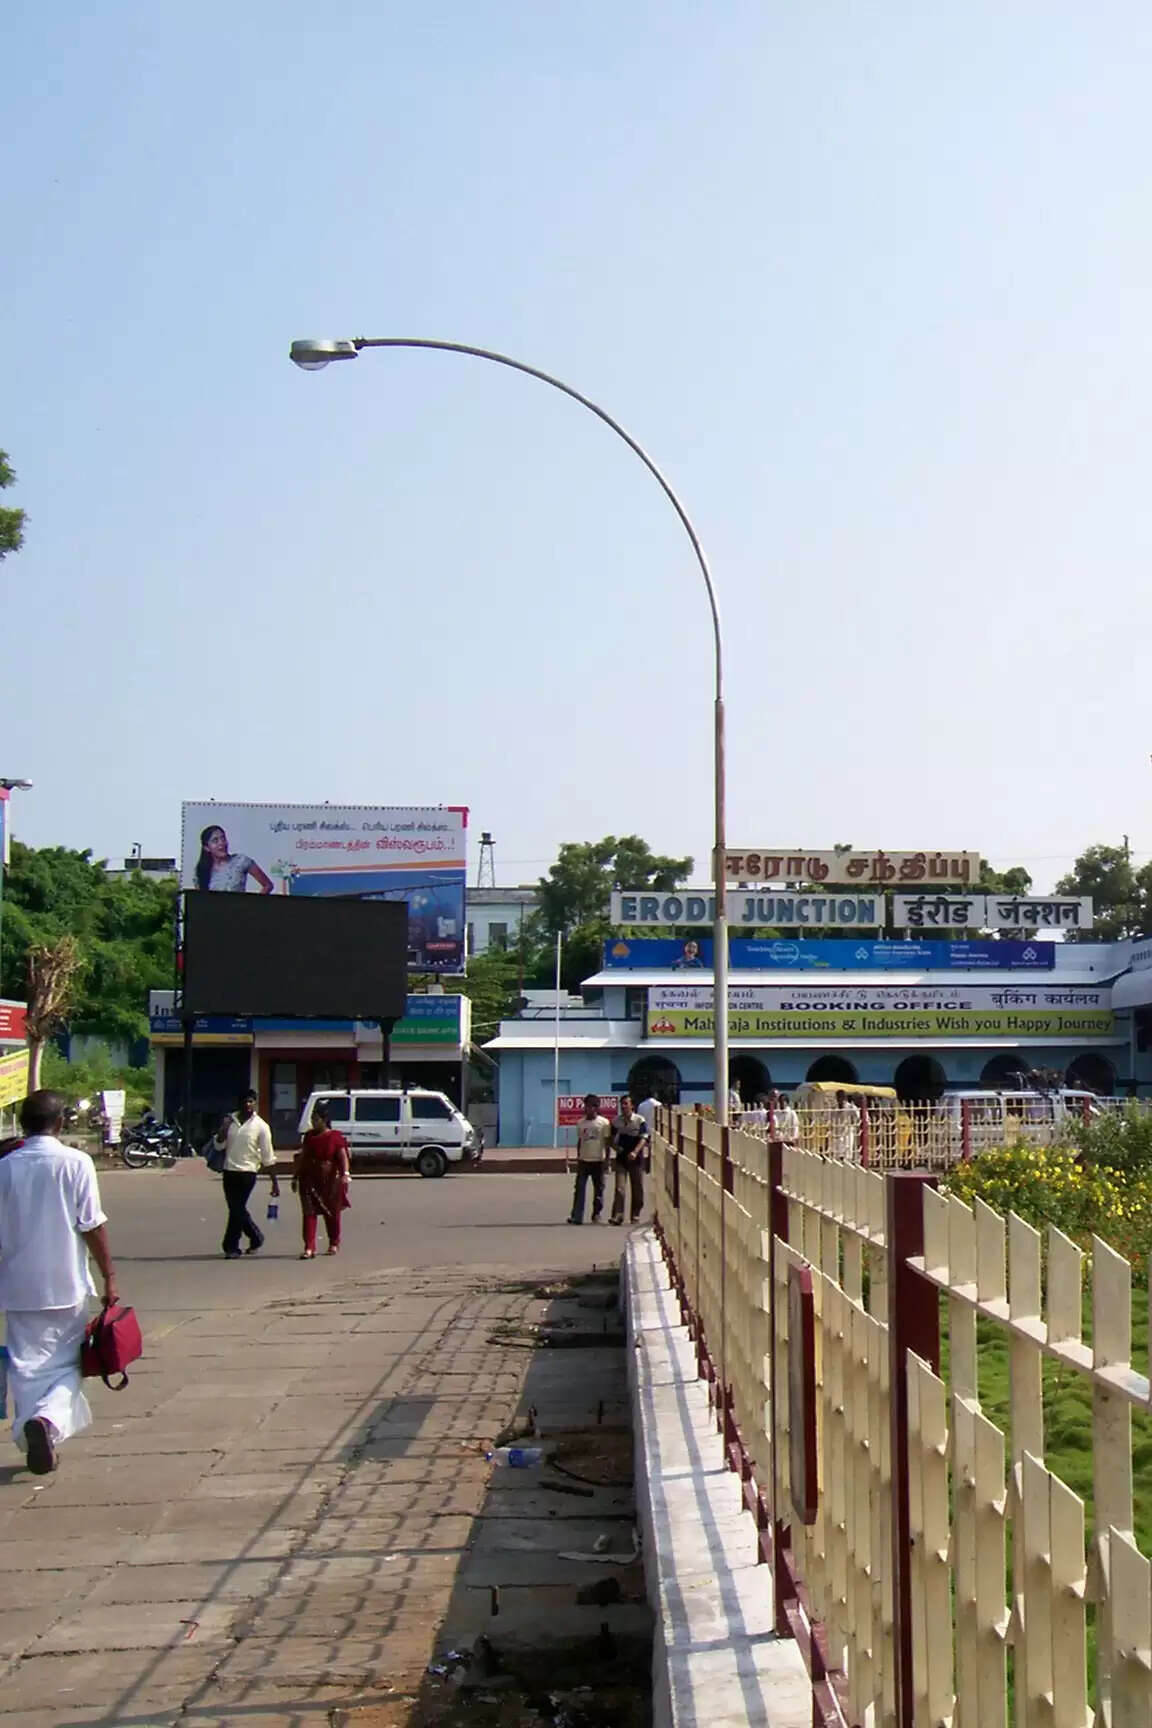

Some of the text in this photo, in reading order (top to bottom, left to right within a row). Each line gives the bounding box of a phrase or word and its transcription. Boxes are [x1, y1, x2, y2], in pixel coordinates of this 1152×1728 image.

[726, 852, 971, 882] ஈரோடு சந்திப்பு
[742, 897, 876, 923] JUNCTION
[780, 1001, 973, 1010] BOOKING OFFICE
[684, 1016, 1112, 1035] Mahaja Institutions & Industries Wish you Happy Journey
[560, 1097, 617, 1109] NO PAING
